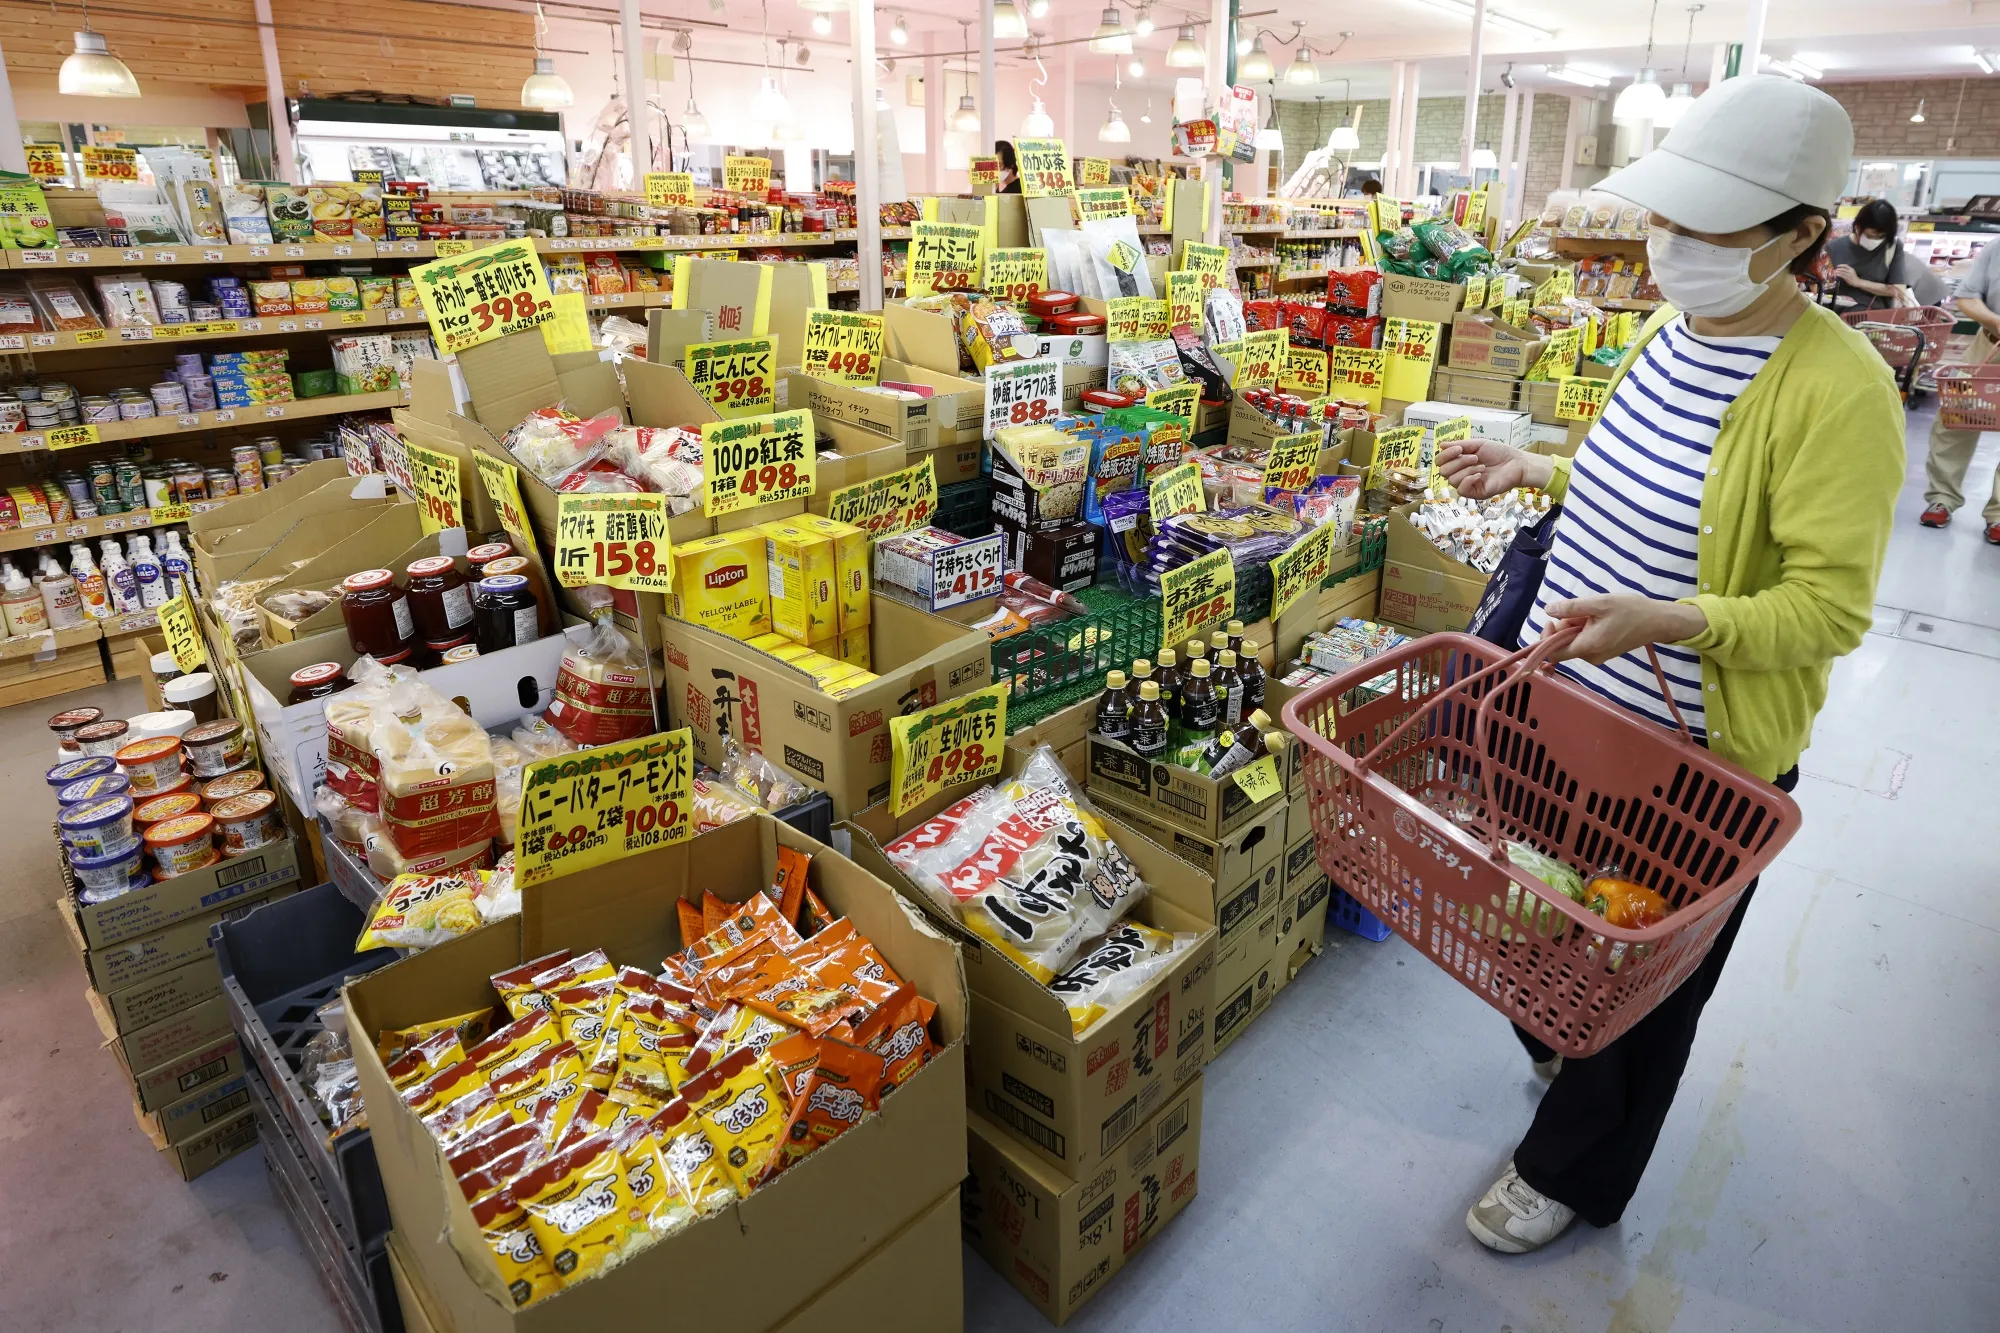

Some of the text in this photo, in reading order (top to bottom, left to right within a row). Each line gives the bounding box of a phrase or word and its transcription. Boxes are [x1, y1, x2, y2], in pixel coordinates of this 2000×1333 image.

[1022, 153, 1067, 172] めかぶ茶
[388, 200, 410, 208] SPAM
[395, 226, 418, 234] SPAM
[918, 237, 977, 261] オートミール
[471, 291, 552, 333] 398円
[693, 353, 769, 384] 黒にんにく
[828, 351, 876, 375] 498円
[1334, 355, 1383, 370] カップラーメン
[714, 376, 771, 403] 398円
[1347, 369, 1381, 385] 118円
[1010, 399, 1059, 424] 88円
[1269, 443, 1319, 469] あまざけ
[710, 476, 737, 494] 1箱
[739, 463, 810, 497] 498円
[560, 515, 595, 540] ヤマザキ
[593, 541, 668, 577] 158円
[708, 566, 744, 585] Lipton
[1166, 572, 1215, 607] お茶
[700, 597, 758, 618] YELLOW LABEL
[722, 613, 738, 622] TEA
[1187, 595, 1232, 629] 128円
[939, 713, 997, 753] 生切りもち
[926, 743, 998, 783] 498円
[1239, 766, 1270, 790] 緑茶
[521, 755, 687, 828] ハニーバターアーモンド
[597, 800, 688, 837] 2袋 100円
[521, 825, 596, 858] 1袋 60円
[1419, 832, 1473, 880] アキダイ
